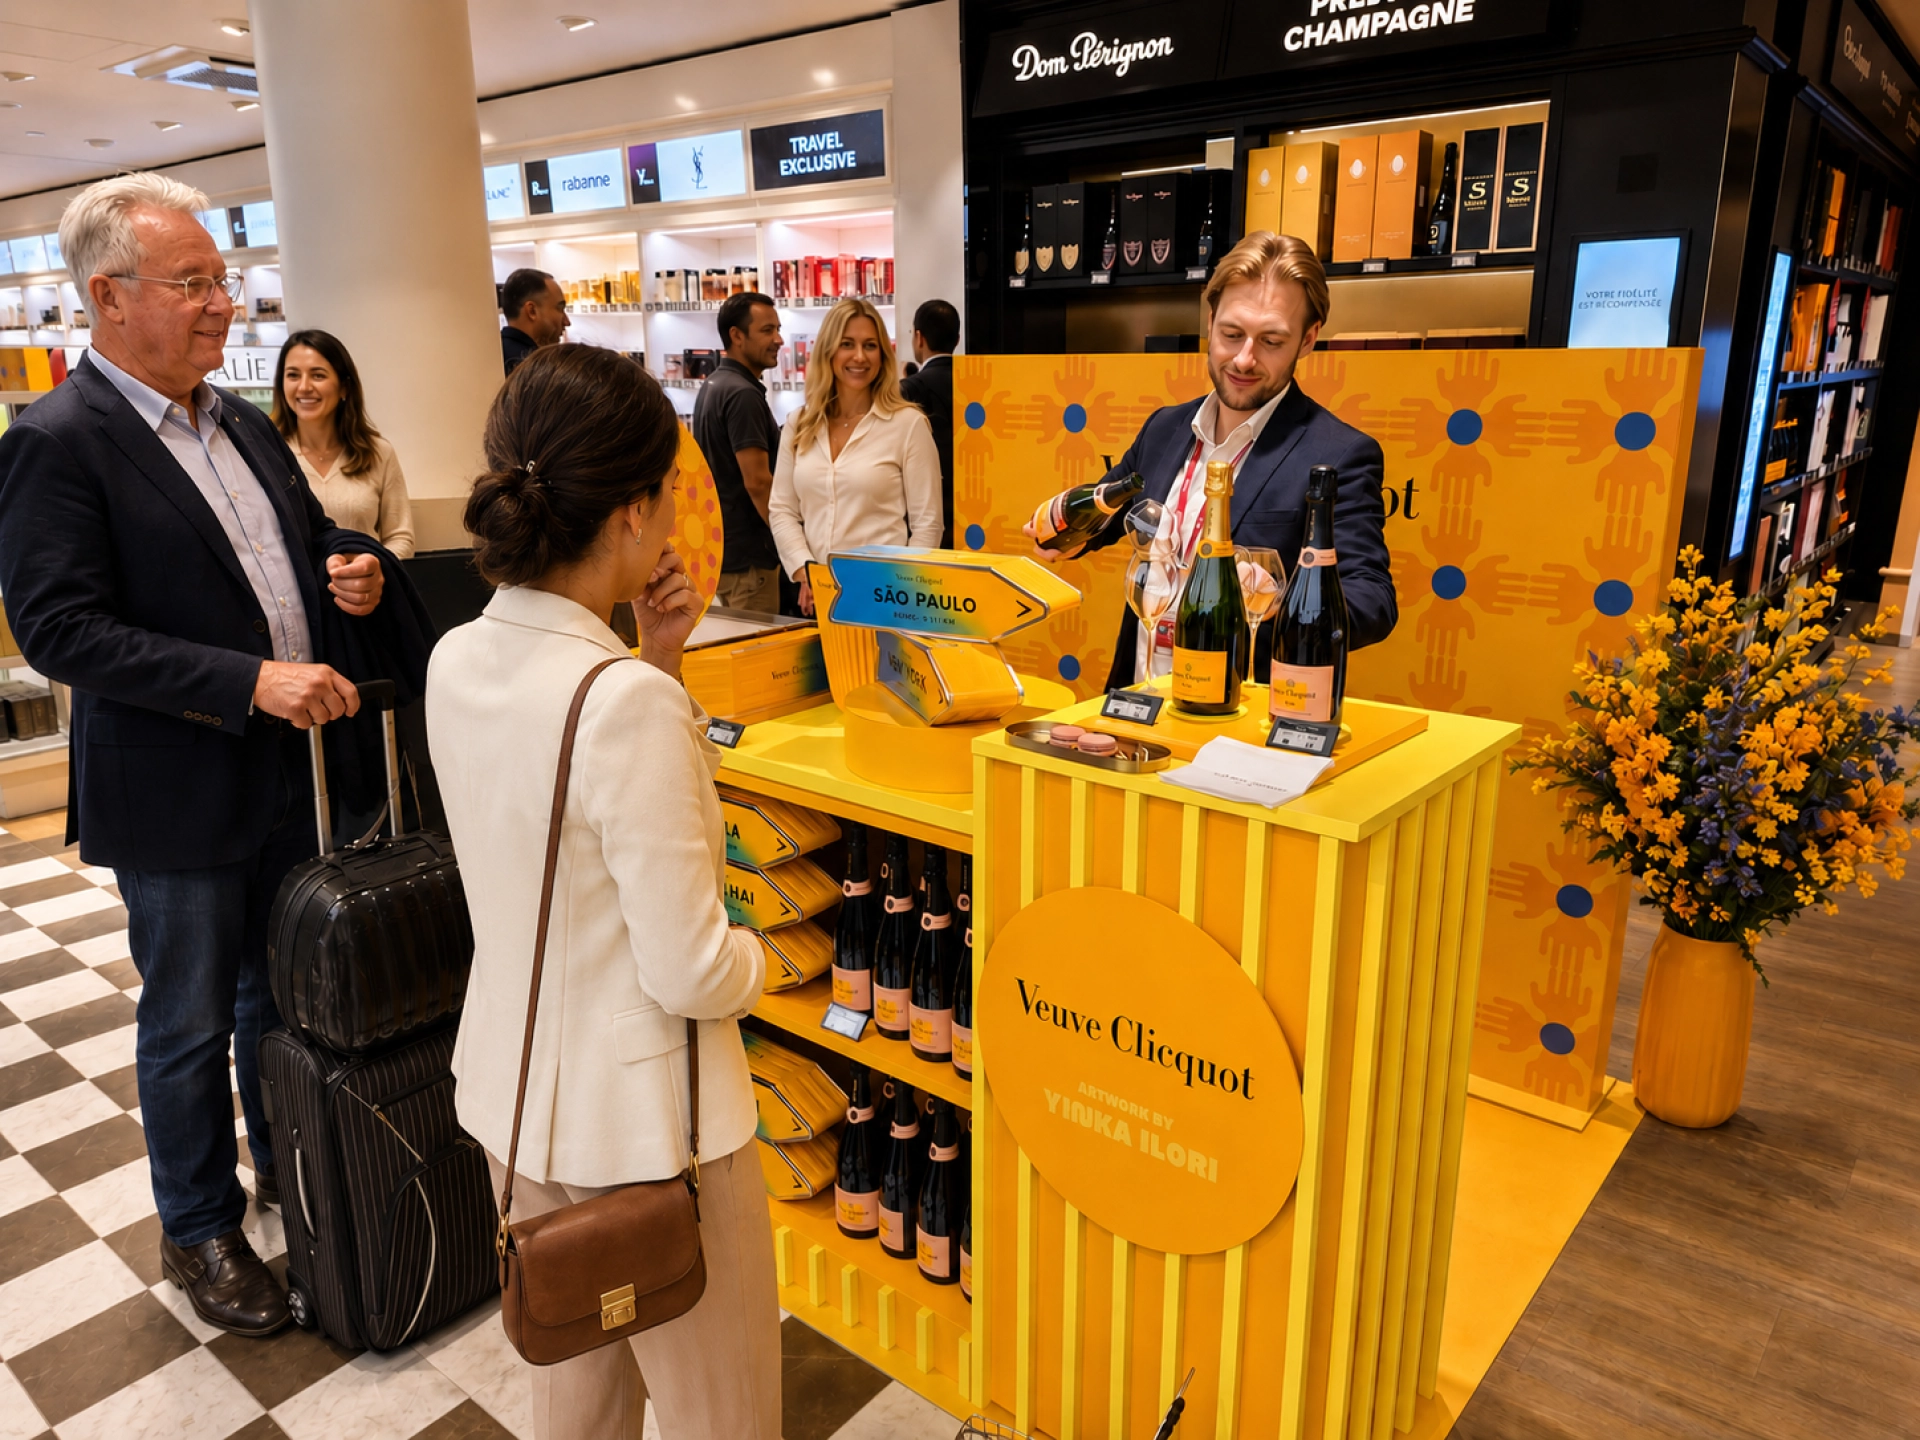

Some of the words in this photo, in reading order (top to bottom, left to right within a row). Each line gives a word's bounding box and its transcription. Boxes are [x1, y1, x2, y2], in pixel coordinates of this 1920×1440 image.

[1284, 0, 1475, 52] CHAMPAGNE
[1012, 44, 1069, 82] Dom
[1070, 31, 1174, 78] Pérignon
[789, 131, 844, 154] TRAVEL
[780, 150, 857, 176] EXCLUSIVE
[562, 174, 611, 191] rabanne
[1585, 290, 1615, 299] VOTRE
[1617, 288, 1658, 299] FIDÉLITÉ
[873, 584, 909, 606] SÃO
[915, 592, 977, 614] PAULO
[724, 882, 754, 906] HAI
[1014, 976, 1102, 1042] Veuve
[1110, 1015, 1255, 1100] Clicquot
[1077, 1081, 1150, 1122] ARTWORK
[1153, 1111, 1174, 1131] BY
[1043, 1087, 1133, 1148] YINKA
[1140, 1128, 1218, 1184] ILORI
